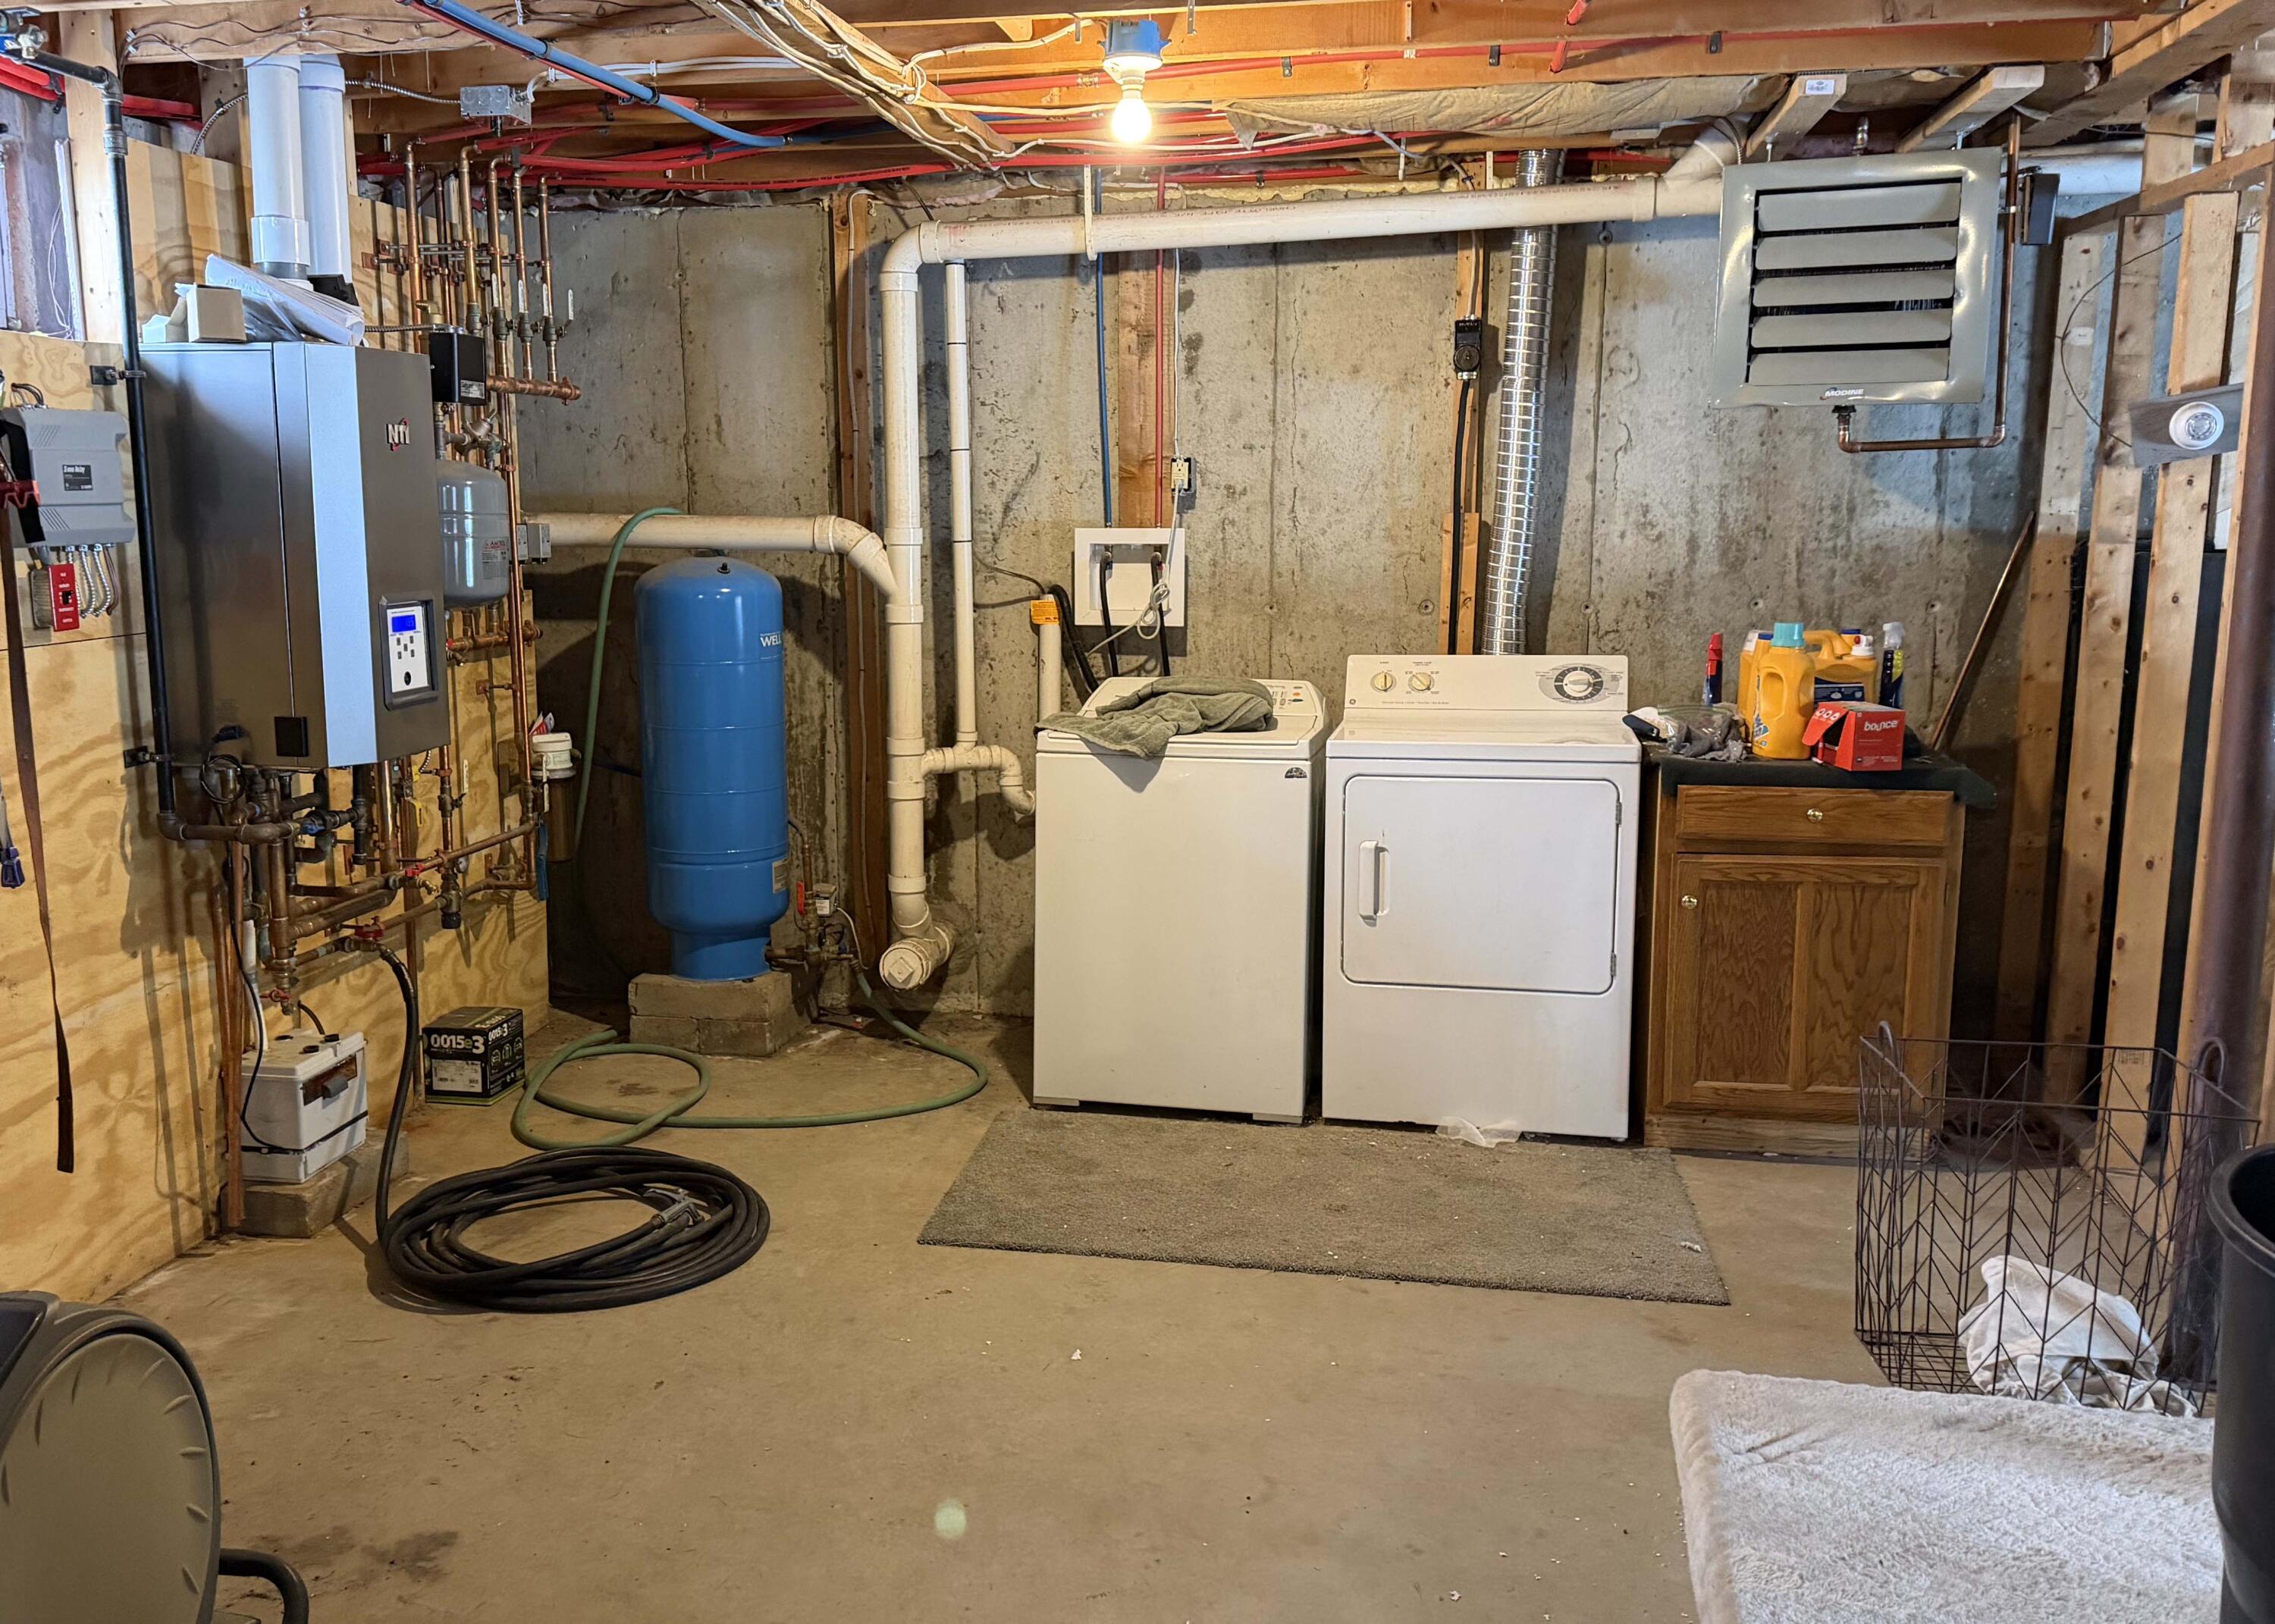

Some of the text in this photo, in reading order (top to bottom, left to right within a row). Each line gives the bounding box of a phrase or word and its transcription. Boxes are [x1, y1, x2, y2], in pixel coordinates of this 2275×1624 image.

[1824, 388, 1865, 397] MODINE
[1863, 720, 1898, 731] bounce
[430, 1033, 485, 1055] 0015e3
